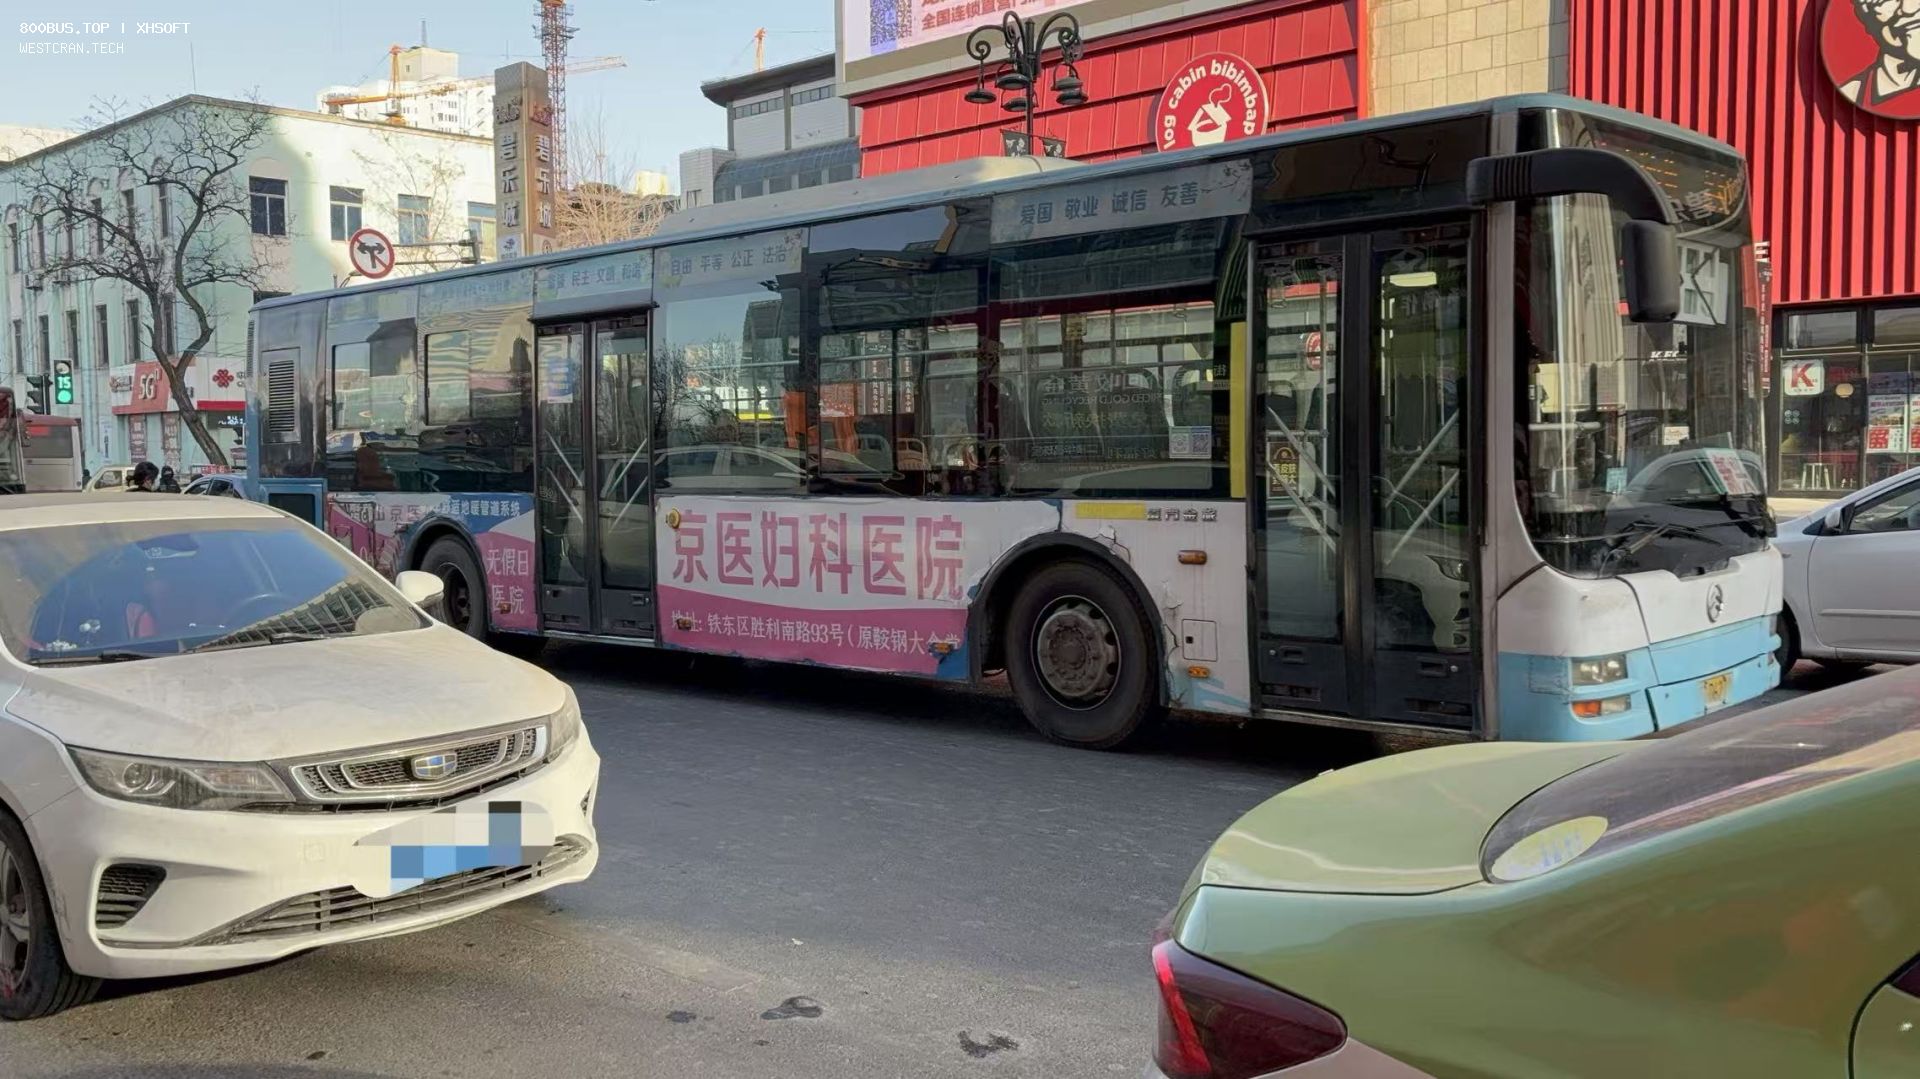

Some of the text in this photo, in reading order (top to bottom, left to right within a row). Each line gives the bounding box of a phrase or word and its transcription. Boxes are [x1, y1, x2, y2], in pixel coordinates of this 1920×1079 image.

[1163, 59, 1258, 150] log cabin bibimbap
[1020, 181, 1199, 225] 爱国 敬业 诚信 友善
[669, 242, 787, 276] 自由 平等 公正 法治
[57, 375, 71, 389] 15
[486, 548, 530, 576] 无假日
[671, 508, 966, 602] 京医妇科医院
[490, 584, 525, 615] 医院
